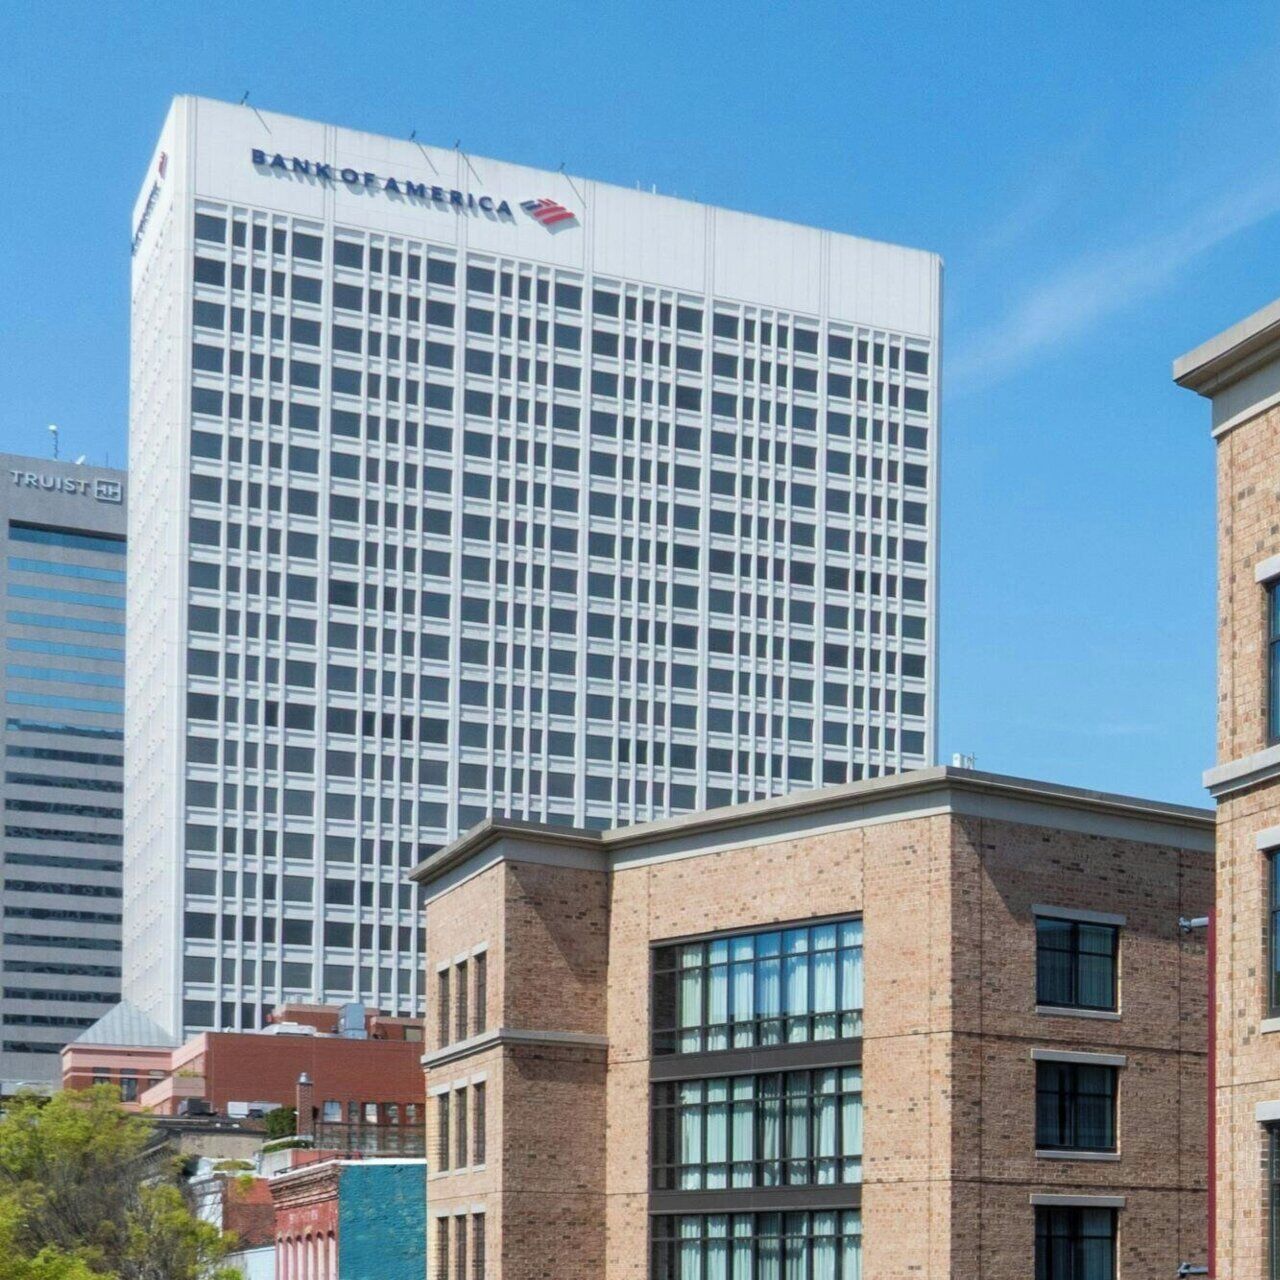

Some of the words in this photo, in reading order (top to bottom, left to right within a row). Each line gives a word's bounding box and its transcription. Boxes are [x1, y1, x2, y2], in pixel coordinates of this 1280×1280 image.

[252, 148, 331, 180] BANK
[341, 168, 376, 188] OF
[385, 178, 513, 215] AMERICA
[10, 470, 90, 493] TRUIST
